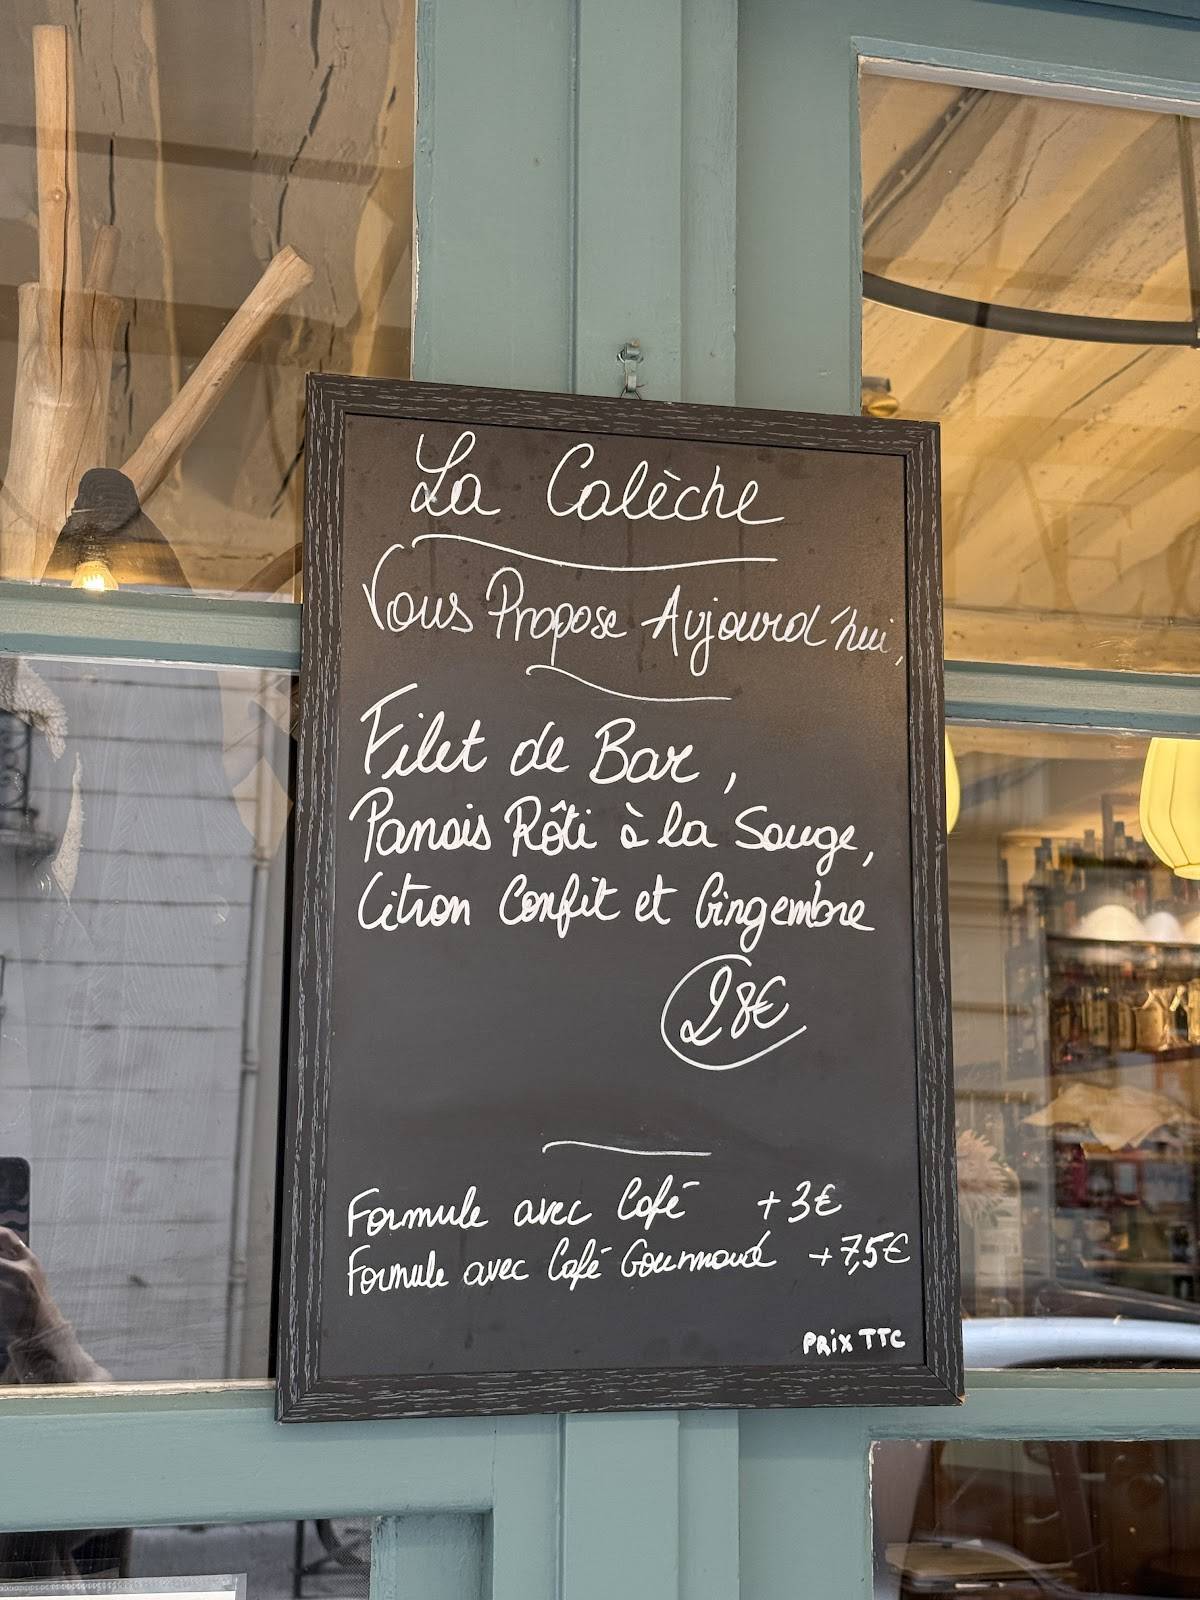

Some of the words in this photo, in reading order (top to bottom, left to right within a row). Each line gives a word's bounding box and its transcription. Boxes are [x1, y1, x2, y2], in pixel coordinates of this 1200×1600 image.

[410, 431, 501, 516] La
[547, 443, 785, 525] Calèche
[362, 543, 473, 634] Vous
[486, 567, 626, 665] Propose
[360, 682, 488, 780] Filet
[510, 721, 570, 776] de
[349, 786, 492, 863] Panais
[504, 795, 597, 858] Rôti
[619, 802, 649, 849] à
[657, 801, 718, 849] la
[734, 805, 874, 875] Sauge,
[356, 871, 471, 931] Citron
[499, 874, 620, 938] Confit
[635, 874, 678, 925] et
[695, 871, 875, 952] Gingembre
[679, 965, 789, 1048] 28€
[348, 1186, 490, 1237] Formule
[513, 1197, 593, 1226] avec
[616, 1174, 700, 1233] Café
[347, 1244, 450, 1296] Formule
[463, 1257, 530, 1287] avec
[547, 1238, 612, 1292] Café
[620, 1231, 777, 1277] Gourmand
[860, 1330, 905, 1350] TTC
